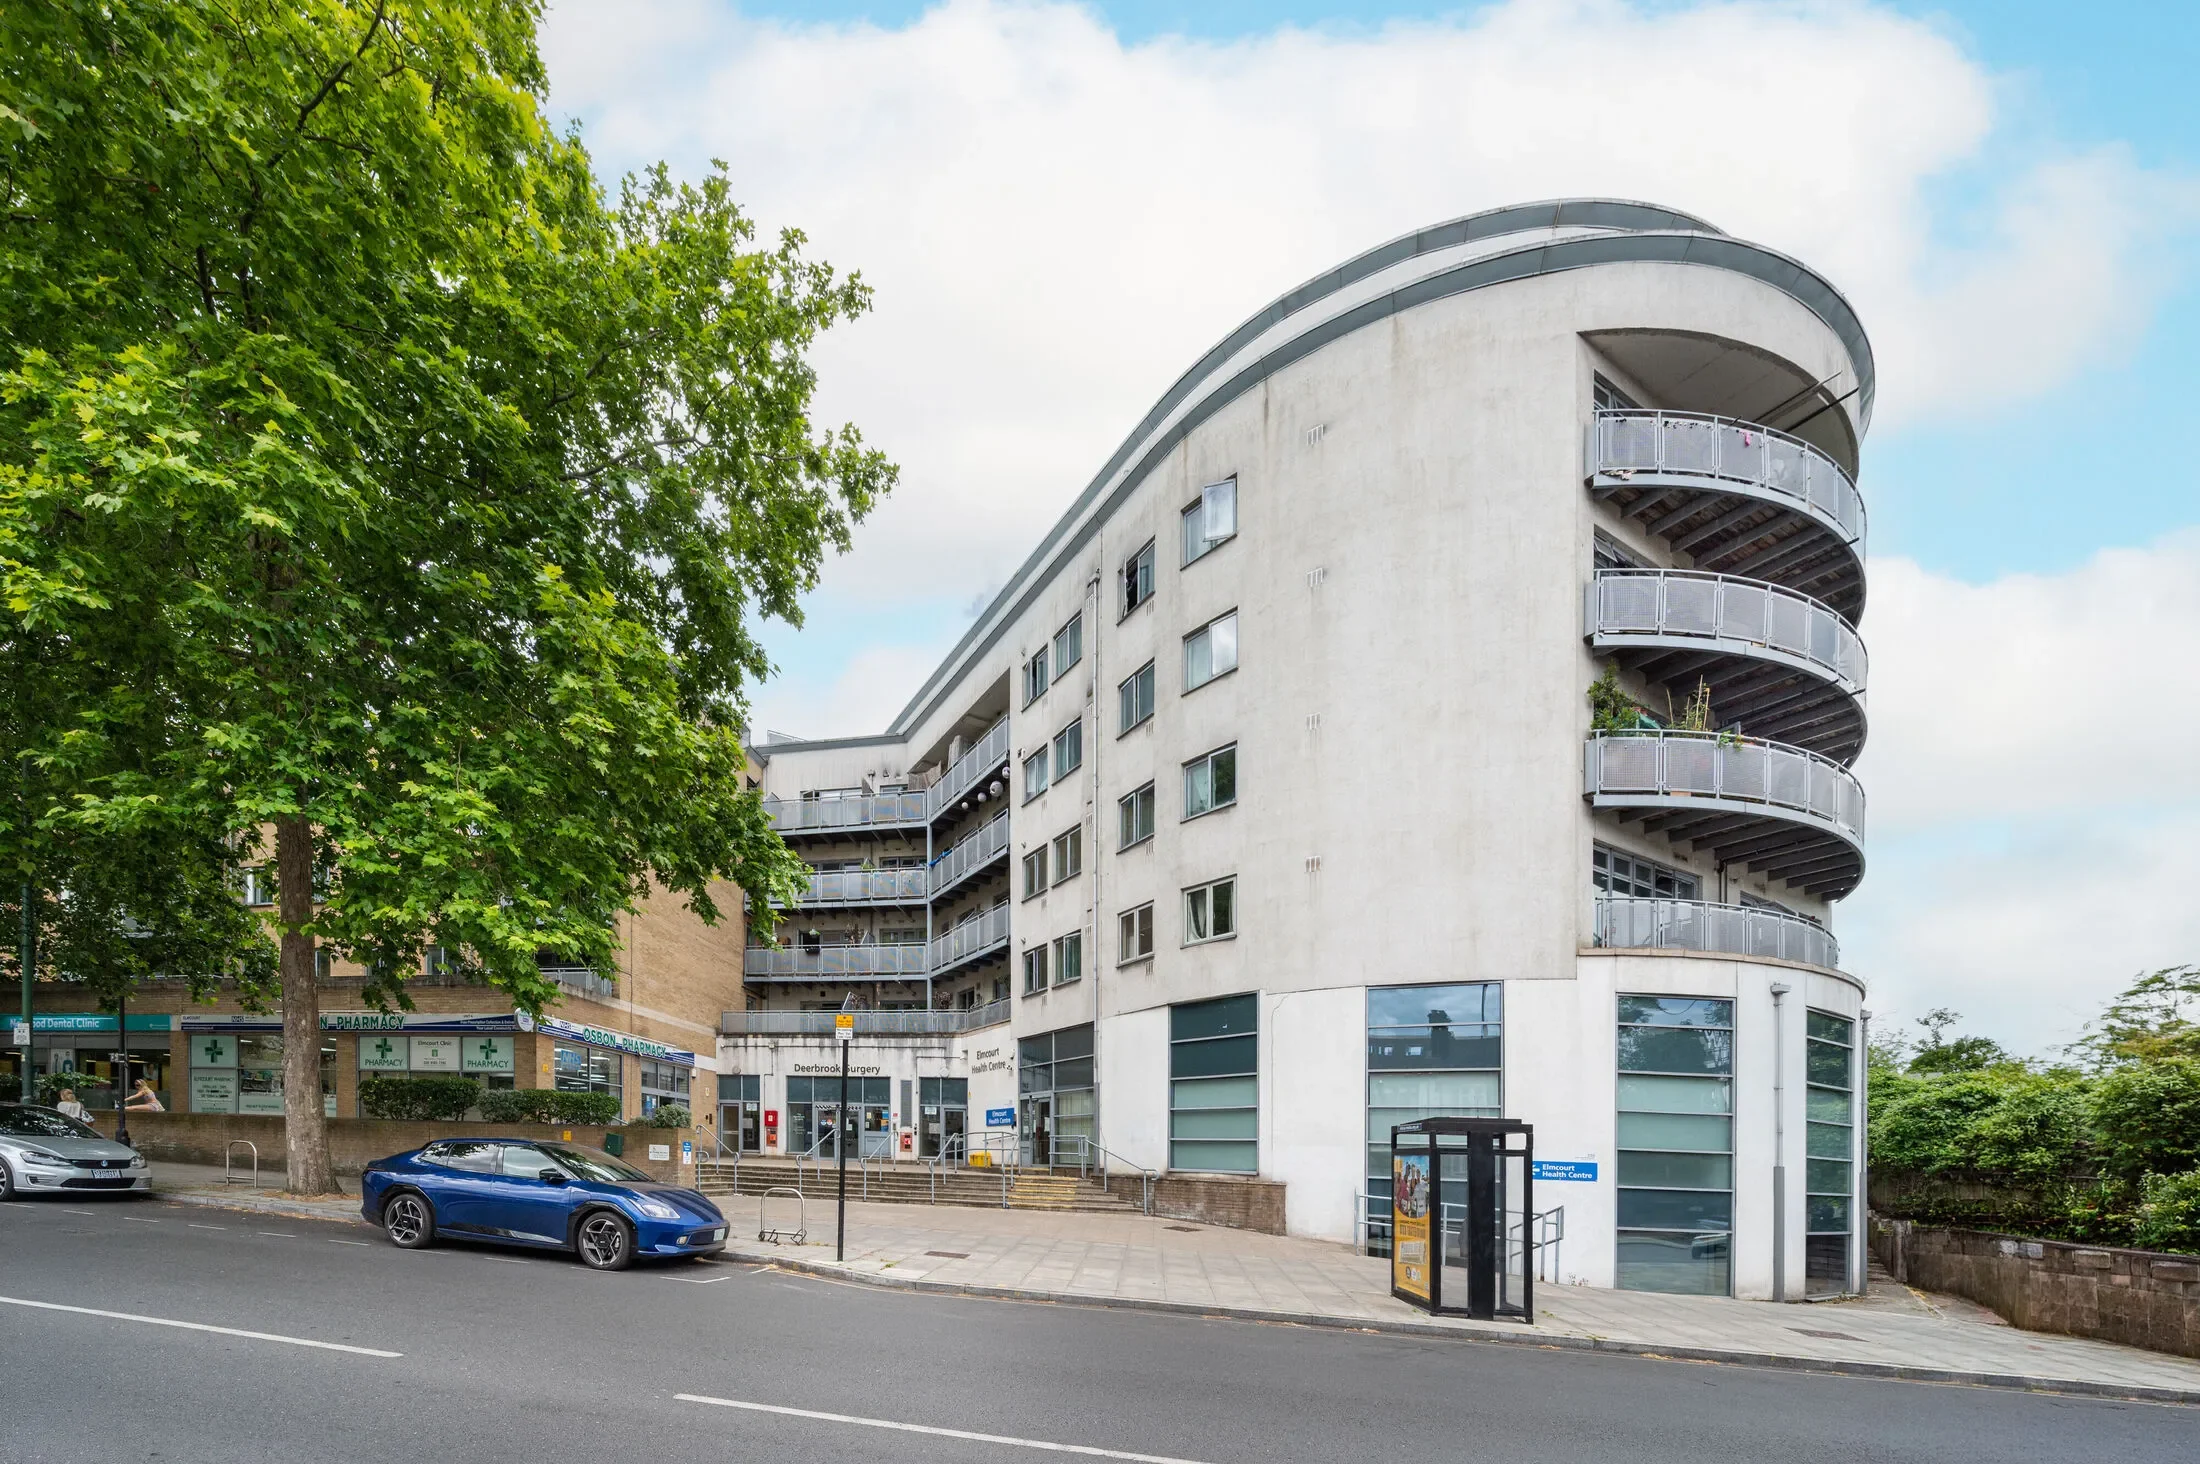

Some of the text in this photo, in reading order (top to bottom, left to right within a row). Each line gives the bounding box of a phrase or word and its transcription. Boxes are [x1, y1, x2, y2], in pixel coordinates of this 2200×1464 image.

[48, 1018, 74, 1028] Dental
[76, 1018, 100, 1028] Clinic
[336, 1016, 405, 1030] PHARMACY
[583, 1027, 617, 1048] OSBON
[622, 1037, 667, 1058] PHARMACY
[562, 1052, 581, 1064] NHS
[976, 1047, 999, 1060] Elmcourt
[364, 1059, 404, 1067] PHARMACY
[467, 1060, 509, 1069] PHARMACY
[794, 1063, 841, 1073] Deerbrook
[971, 1061, 1006, 1075] Health Centre
[992, 1110, 1007, 1118] Elmcourt
[1542, 1163, 1575, 1171] Elmcourt
[1542, 1170, 1593, 1179] Health Centre
